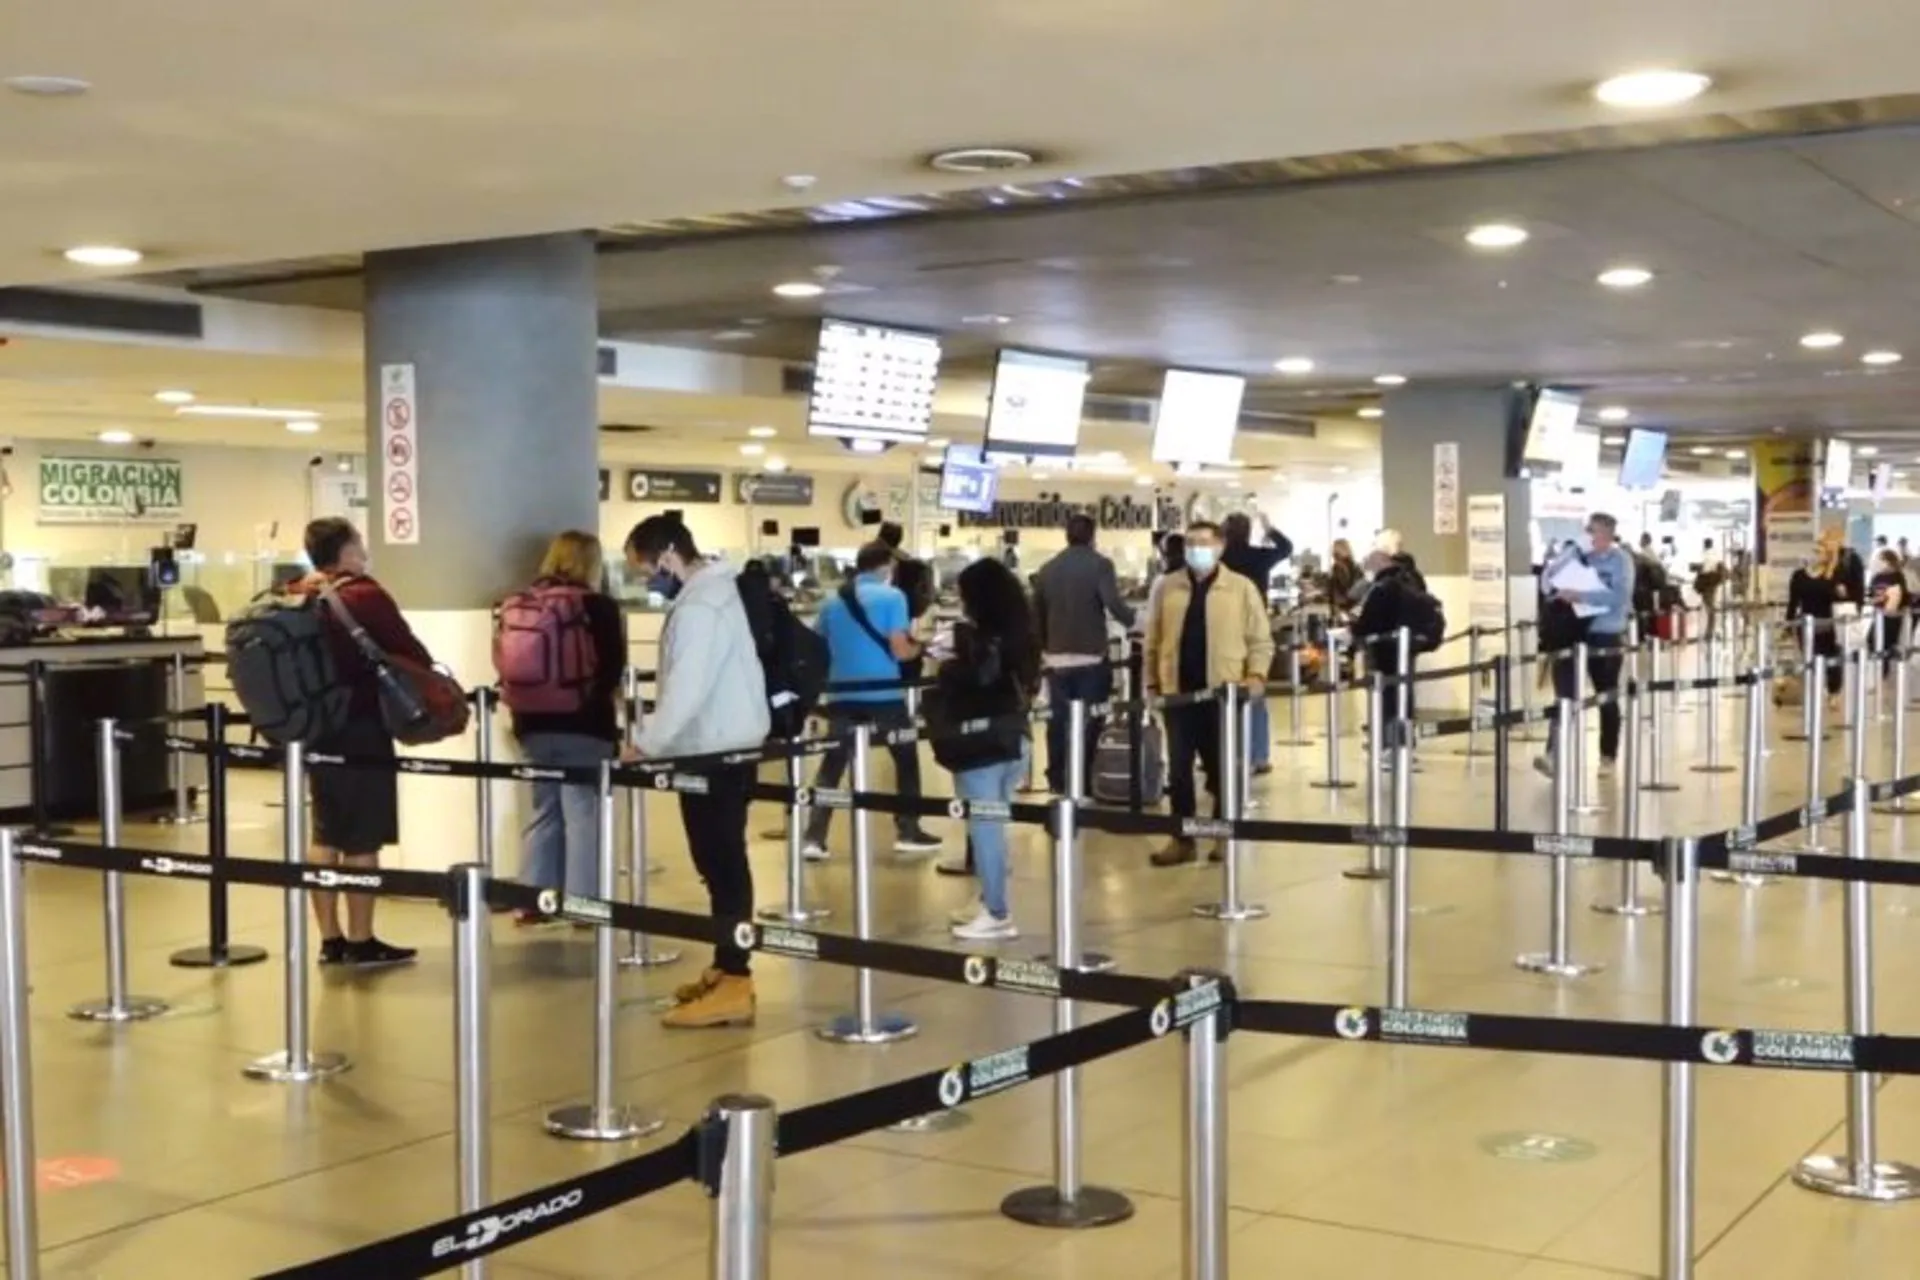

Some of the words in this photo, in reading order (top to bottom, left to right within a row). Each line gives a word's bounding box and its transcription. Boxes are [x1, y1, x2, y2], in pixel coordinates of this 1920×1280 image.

[40, 461, 181, 486] MIGRACIÓN
[42, 484, 179, 505] COLOMBIA
[1753, 1044, 1853, 1061] COLOMBIA
[466, 1187, 584, 1251] DORADO
